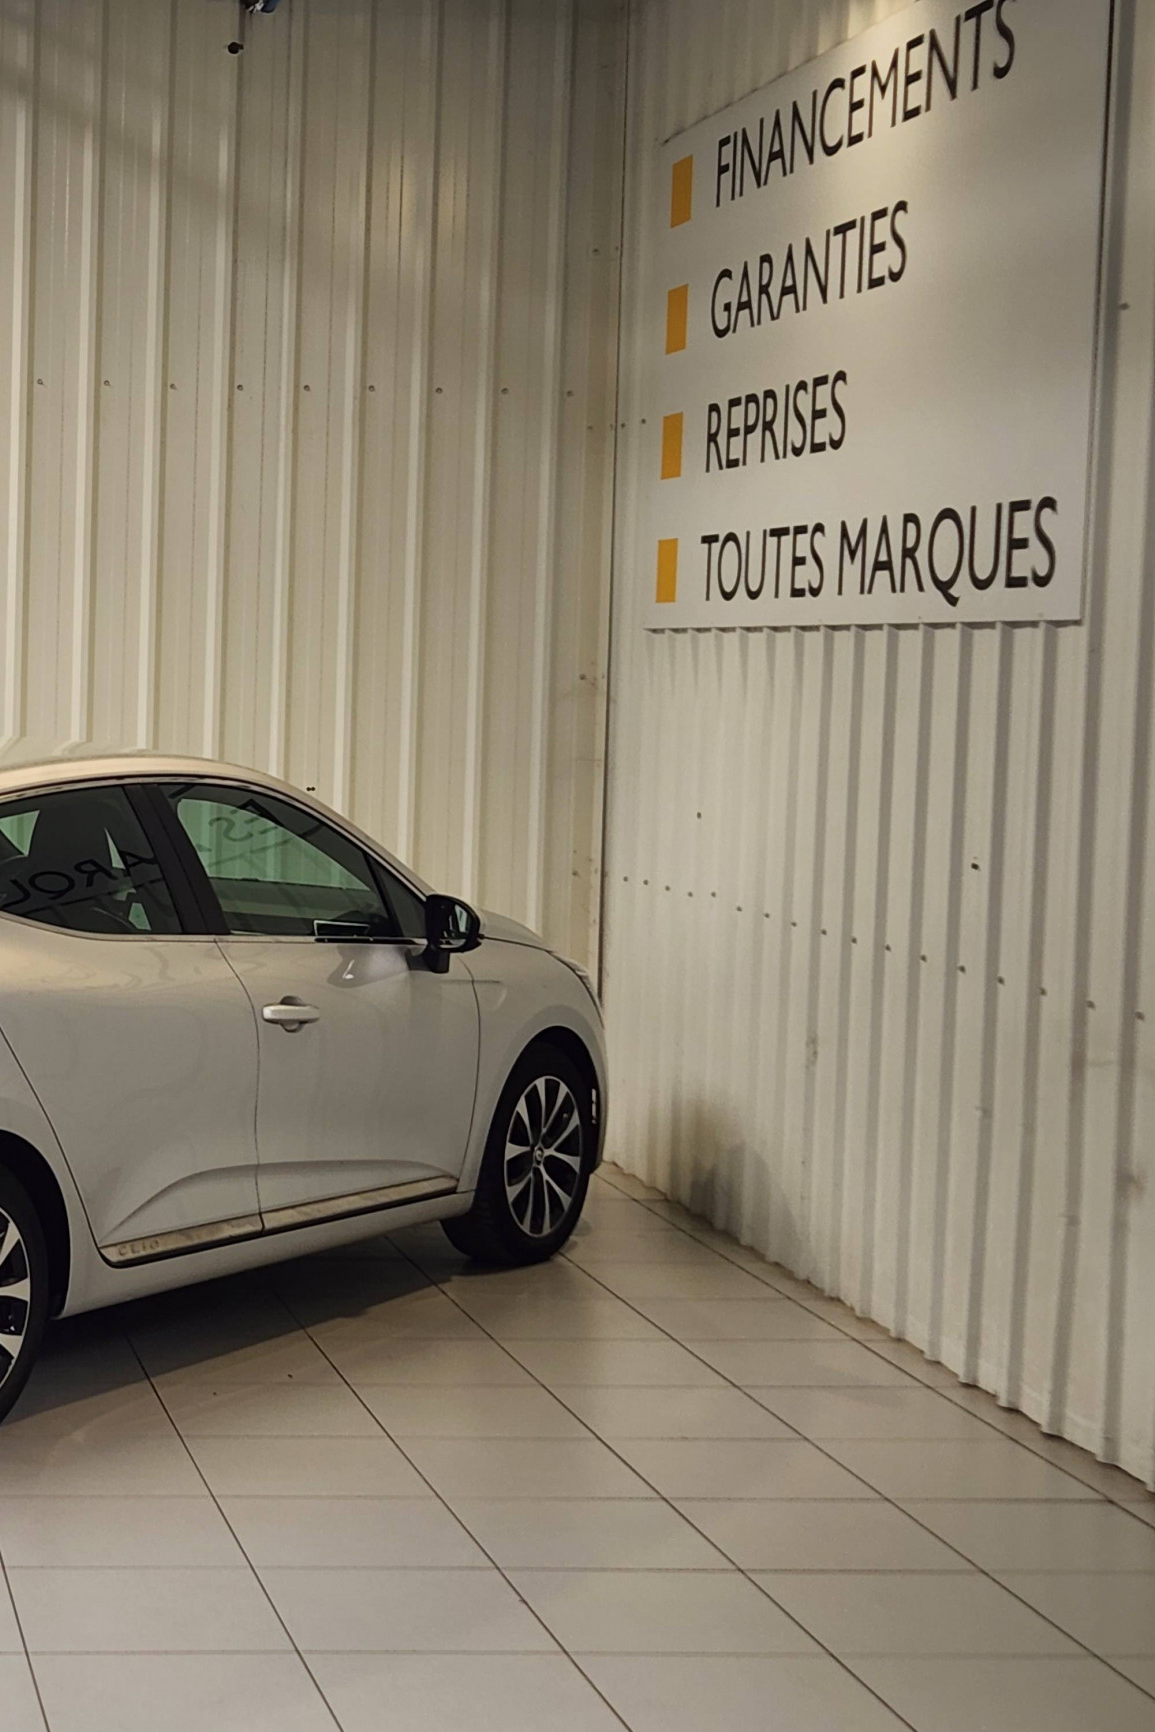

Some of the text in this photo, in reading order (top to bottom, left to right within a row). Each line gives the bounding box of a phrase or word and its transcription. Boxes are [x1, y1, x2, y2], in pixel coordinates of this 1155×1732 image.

[715, 0, 1016, 208] FINANCEMENTS
[710, 199, 908, 338] GARANTIES
[705, 369, 848, 474] REPRISES
[700, 495, 1058, 608] TOUTES MARQUES
[117, 1239, 159, 1257] CLIO
